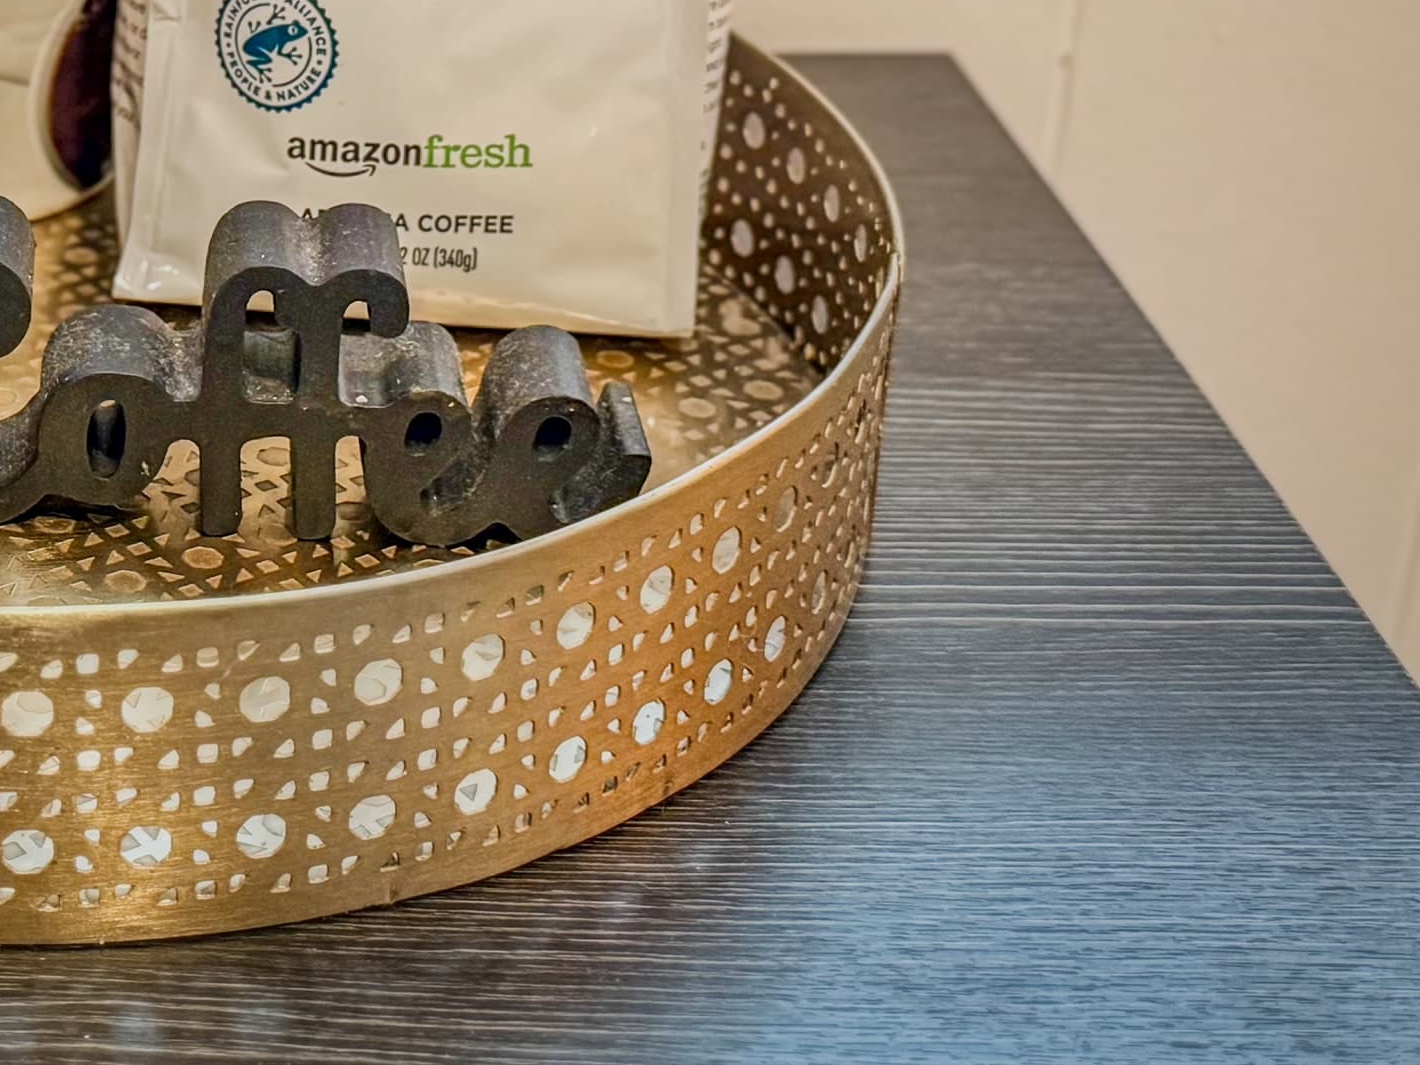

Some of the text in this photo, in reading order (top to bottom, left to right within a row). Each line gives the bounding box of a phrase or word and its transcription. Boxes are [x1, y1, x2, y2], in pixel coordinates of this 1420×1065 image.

[226, 51, 262, 97] PEOPLE
[276, 67, 322, 102] NATURE
[286, 135, 534, 172] amazonfresh
[417, 214, 515, 234] COFFEE
[411, 246, 431, 267] OZ
[433, 246, 479, 273] (340g)
